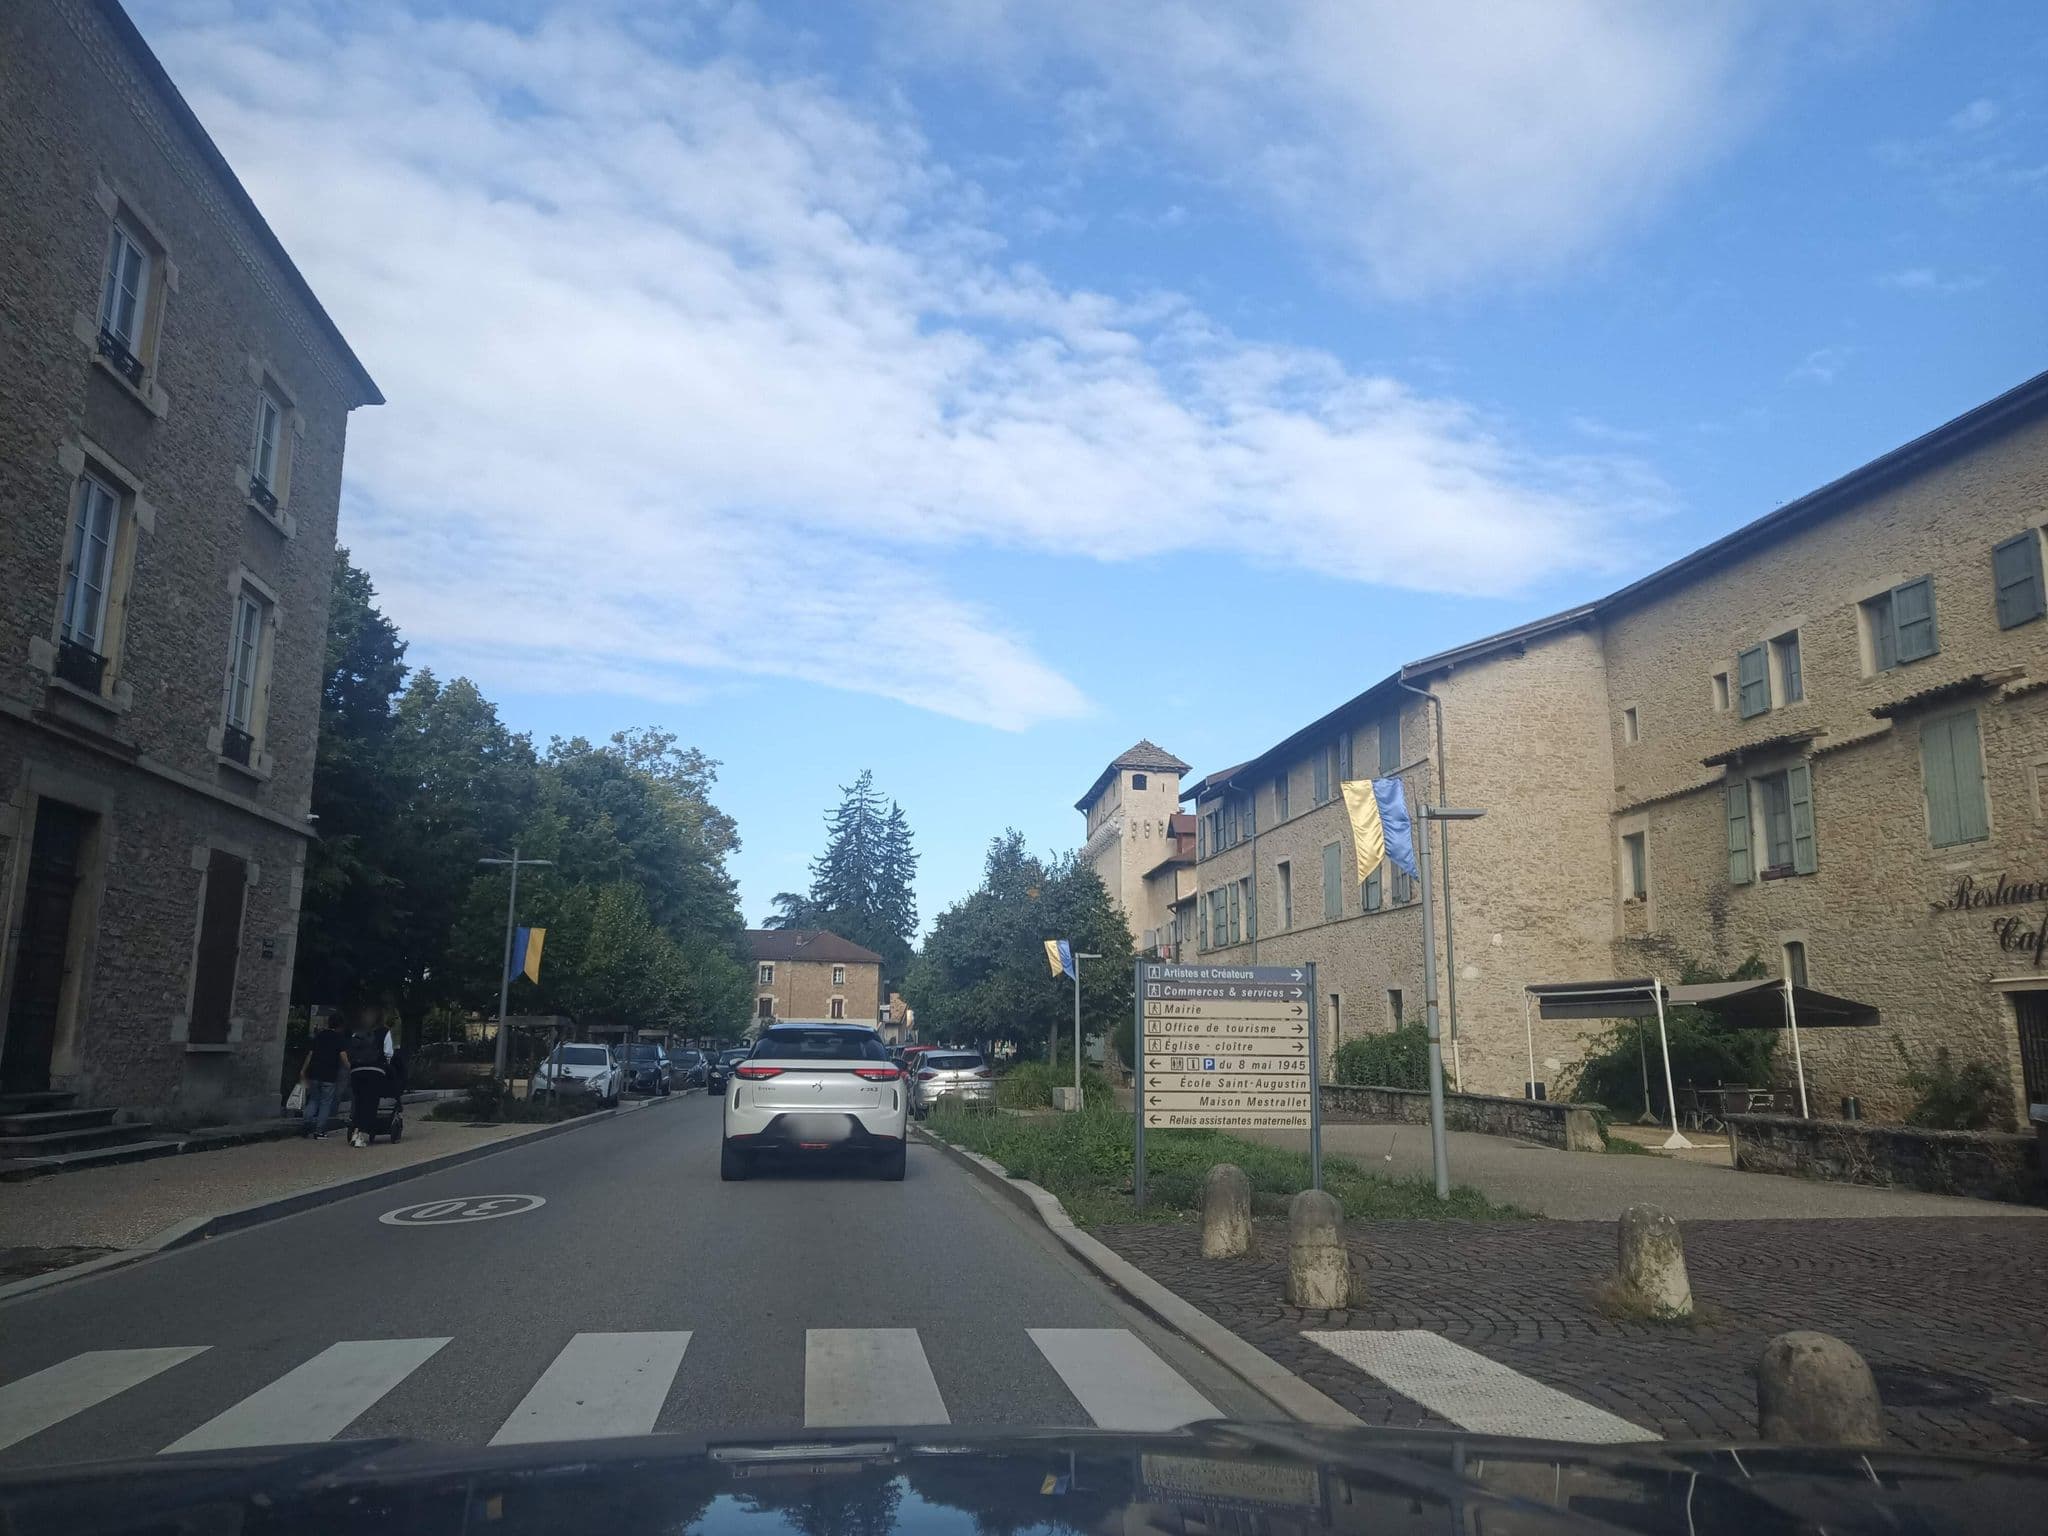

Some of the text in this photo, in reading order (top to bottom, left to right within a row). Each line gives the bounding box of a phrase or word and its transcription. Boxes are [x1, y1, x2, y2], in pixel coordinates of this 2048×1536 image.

[1164, 968, 1254, 979] Artistes et Créateurs
[1164, 986, 1284, 998] Commerces & services
[1164, 1004, 1201, 1014] Mairie
[1165, 1022, 1276, 1033] Office de tourisme
[1165, 1039, 1200, 1052] Église
[1215, 1040, 1253, 1051] cloître
[1219, 1060, 1232, 1069] du
[1239, 1060, 1245, 1069] 8
[1252, 1061, 1272, 1069] mai
[1278, 1060, 1305, 1070] 1945
[1180, 1075, 1307, 1090] École Saint-Augustin
[1200, 1097, 1307, 1107] Maison Mestrallet
[1169, 1115, 1307, 1126] Relais assistantes maternelles
